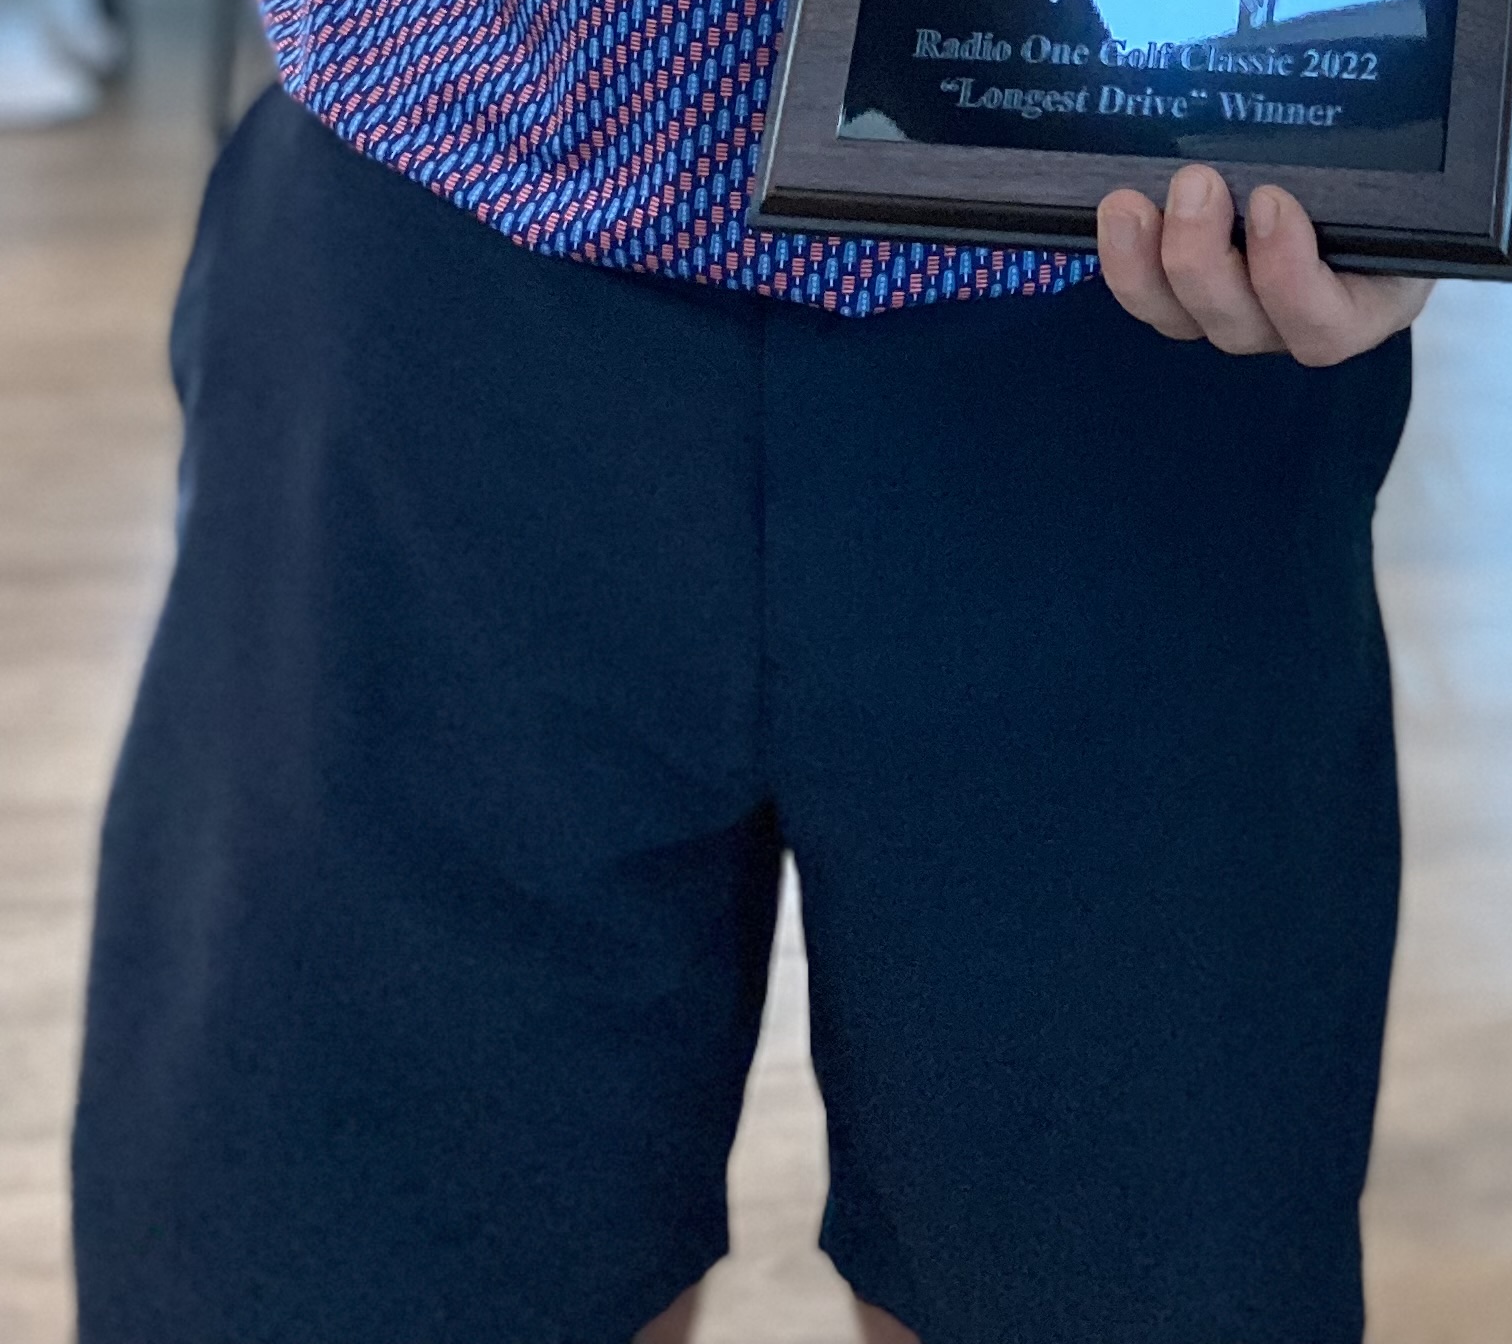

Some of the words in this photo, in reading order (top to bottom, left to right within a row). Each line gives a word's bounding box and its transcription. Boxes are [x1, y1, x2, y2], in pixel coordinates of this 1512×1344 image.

[912, 28, 1012, 62] Radio
[1020, 33, 1090, 66] One
[1101, 39, 1173, 70] Golf
[1181, 43, 1293, 77] Classic
[1300, 48, 1379, 81] 2022
[1220, 91, 1342, 127] Winner
